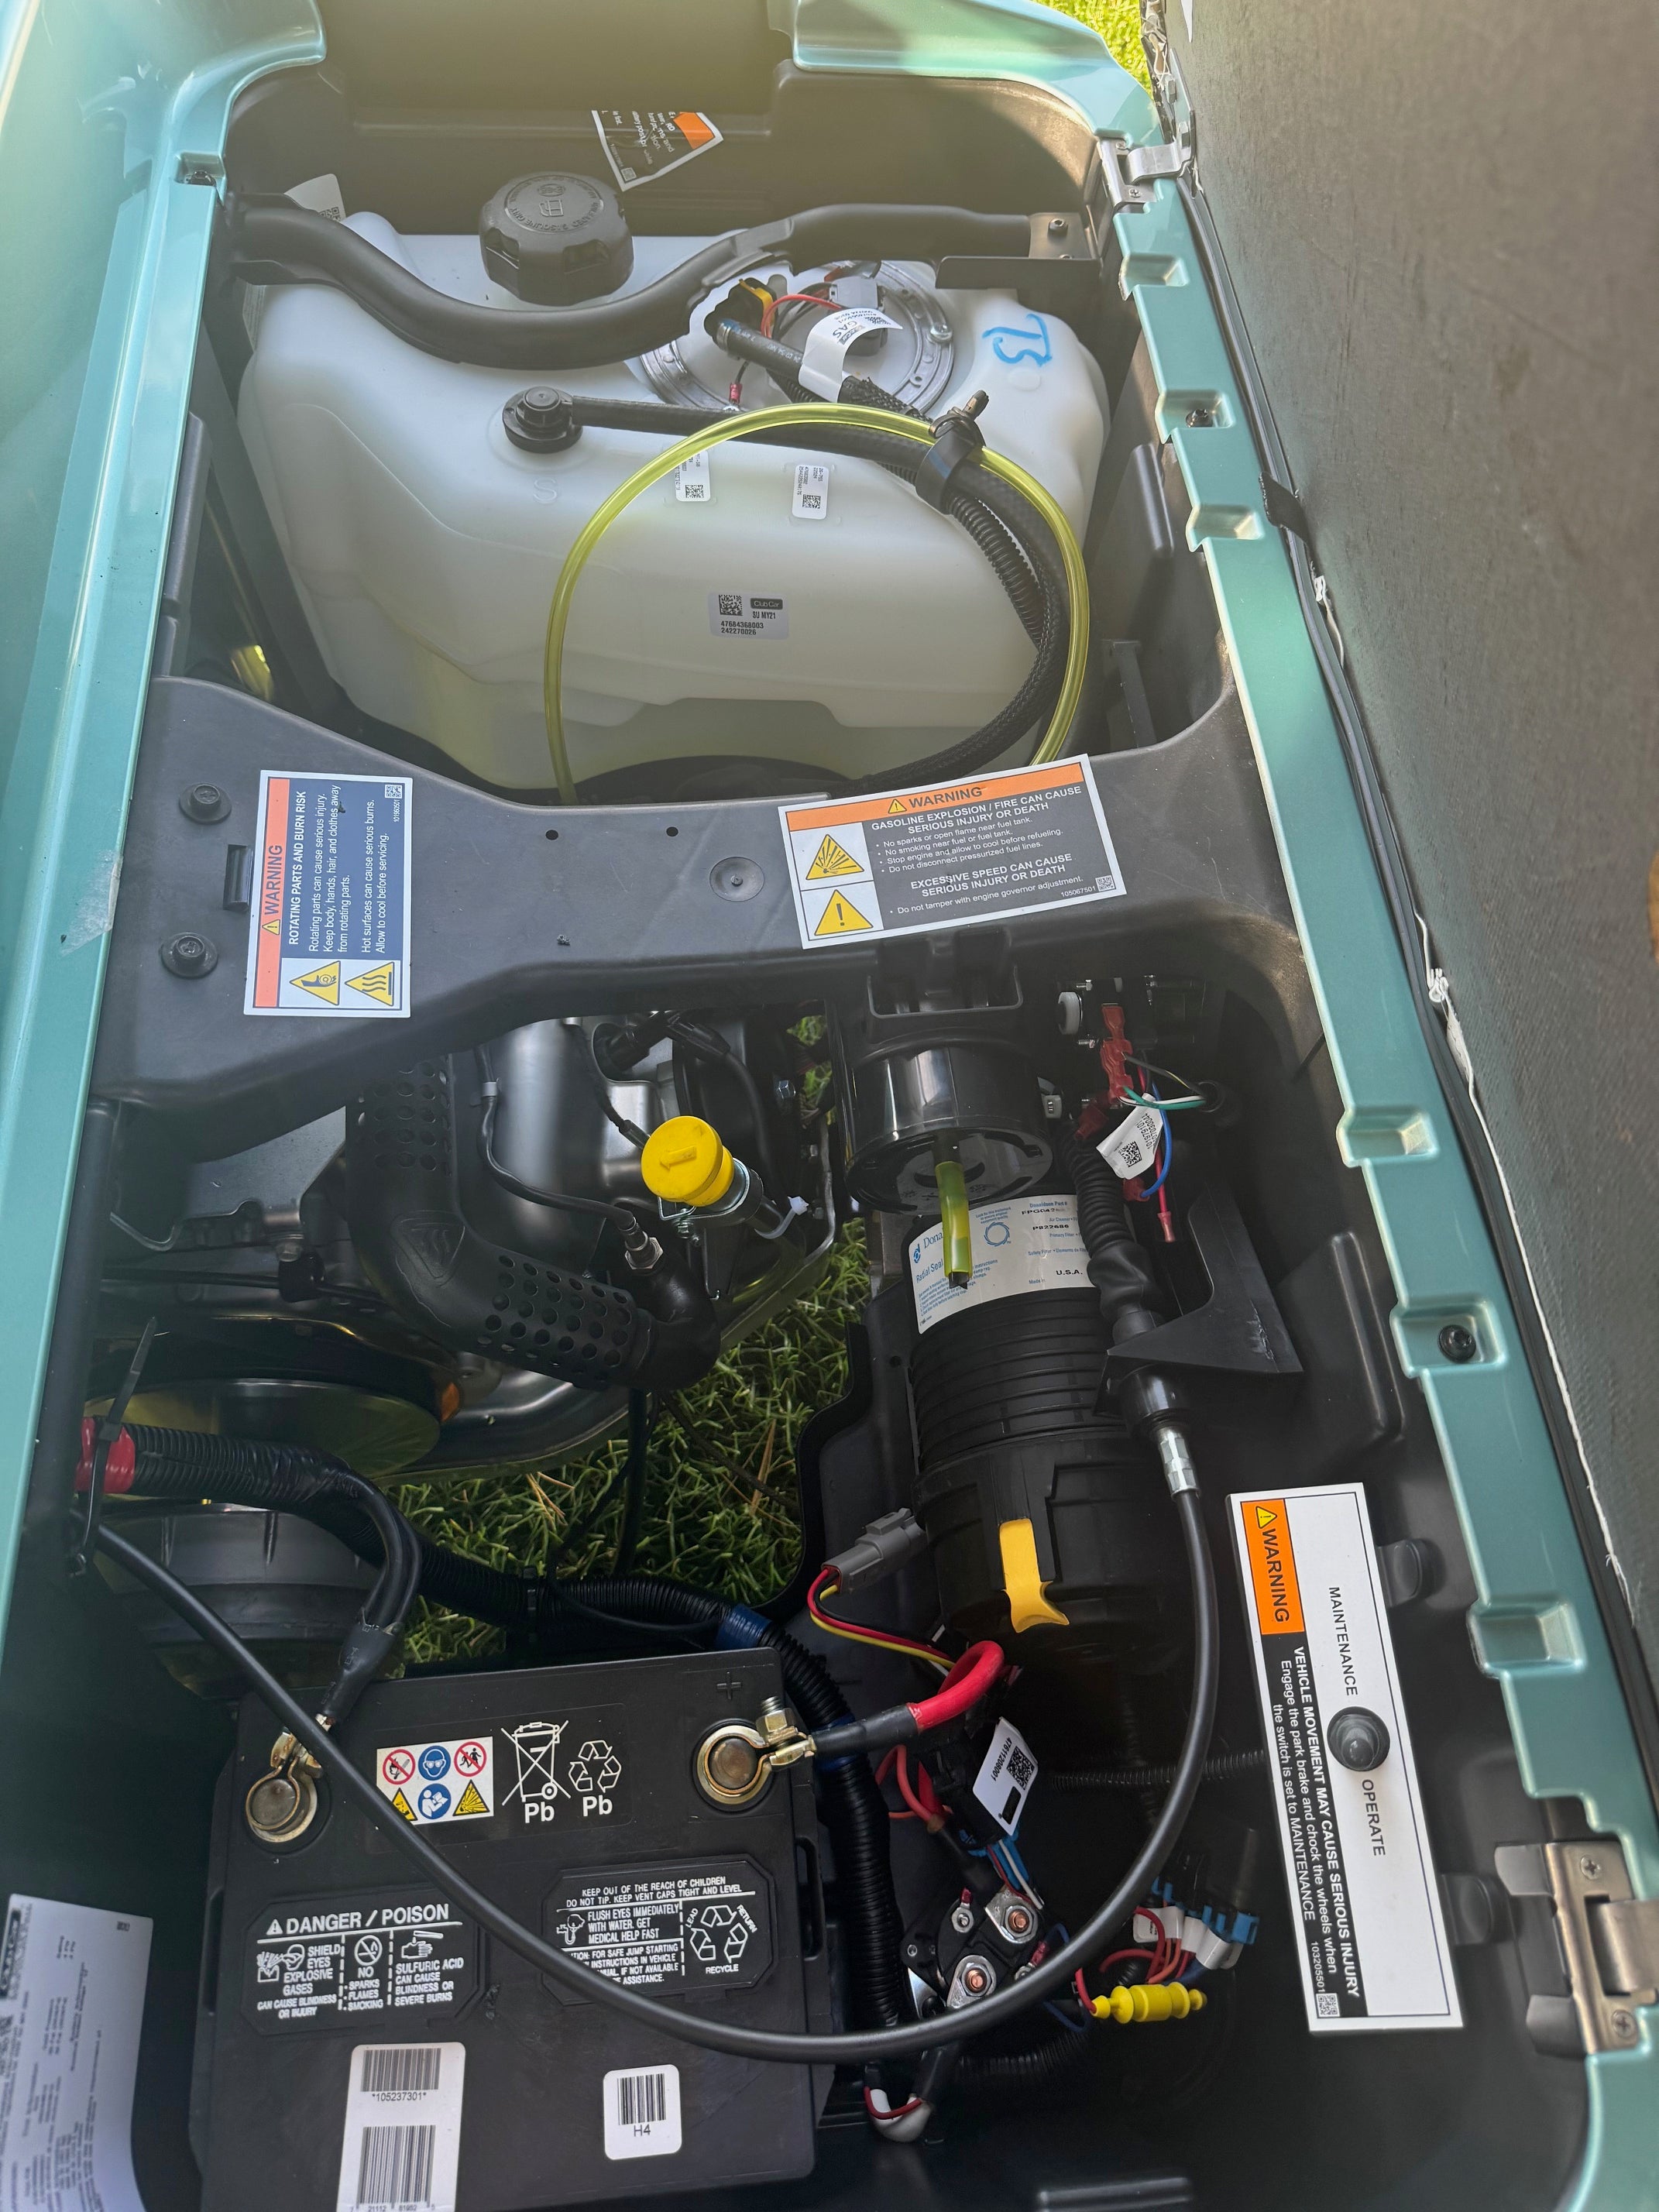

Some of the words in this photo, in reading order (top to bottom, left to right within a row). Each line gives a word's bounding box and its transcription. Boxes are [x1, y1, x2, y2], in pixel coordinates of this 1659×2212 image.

[833, 321, 857, 338] GAS
[295, 791, 306, 812] RISK
[314, 794, 327, 816] injury.
[331, 785, 341, 806] away
[908, 786, 982, 809] WARNING
[871, 815, 925, 830] GASOLINE
[926, 804, 986, 822] EXPLOSION
[994, 799, 1018, 809] FIRE
[1020, 794, 1042, 805] CAN
[1045, 786, 1082, 799] CAUSE
[908, 819, 954, 834] SERIOUS
[956, 812, 993, 826] INJURY
[996, 809, 1012, 819] OR
[1014, 802, 1049, 816] DEATH
[294, 815, 305, 840] BURN
[314, 819, 324, 848] serious
[328, 808, 338, 836] clothes
[897, 836, 922, 846] sparks
[933, 831, 953, 840] open
[954, 827, 976, 836] flame
[997, 819, 1012, 828] fuel
[1013, 816, 1032, 825] tank.
[293, 843, 304, 863] AND
[327, 838, 337, 854] and
[314, 850, 323, 874] cause
[326, 856, 338, 873] hair,
[910, 872, 970, 889] EXCESSIVE
[972, 866, 1008, 878] SPEED
[1010, 861, 1032, 871] CAN
[1035, 854, 1072, 867] CAUSE
[264, 845, 283, 915] WARNING
[291, 864, 302, 895] PARTS
[325, 875, 337, 903] hands,
[340, 874, 352, 898] parts.
[1060, 885, 1096, 897] 105067501
[311, 893, 322, 914] parts
[925, 900, 953, 909] tamper
[954, 896, 971, 905] with
[972, 892, 999, 902] engine
[1001, 885, 1036, 898] governor
[1038, 875, 1084, 890] adjustment.
[288, 897, 301, 945] ROTATING
[324, 904, 337, 928] body,
[338, 899, 352, 931] rotating
[308, 916, 322, 951] Rotating
[323, 929, 336, 952] Keep
[337, 933, 348, 953] from
[1262, 1528, 1290, 1622] WARNING
[1328, 1587, 1358, 1695] MAINTENANCE
[1281, 1660, 1295, 1705] Engage
[1294, 1646, 1312, 1703] VEHICLE
[1288, 1708, 1300, 1727] the
[1290, 1730, 1305, 1757] park
[1303, 1706, 1325, 1784] MOVEMENT
[1297, 1760, 1310, 1794] brake
[524, 1802, 555, 1823] Pb
[582, 1795, 613, 1817] Pb
[1302, 1798, 1316, 1820] and
[1316, 1788, 1331, 1817] MAY
[1362, 1779, 1386, 1856] OPERATE
[1307, 1824, 1321, 1861] chock
[1321, 1820, 1339, 1870] CAUSE
[1313, 1864, 1324, 1885] the
[582, 1887, 601, 1897] KEEP
[603, 1886, 617, 1895] OUT
[620, 1884, 631, 1894] OF
[634, 1883, 648, 1892] THE
[651, 1881, 675, 1891] REACH
[677, 1879, 688, 1888] OF
[689, 1876, 726, 1887] CHILDREN
[588, 1909, 610, 1922] FLUSH
[613, 1908, 631, 1919] EYES
[633, 1903, 679, 1917] IMMEDIATELY
[1317, 1887, 1332, 1934] wheels
[1330, 1873, 1350, 1939] SERIOUS
[287, 1911, 362, 1935] DANGER
[382, 1903, 448, 1925] POISON
[588, 1922, 606, 1932] WITH
[637, 1917, 651, 1929] GET
[685, 1907, 699, 1929] LEAD
[737, 1905, 757, 1934] RETURN
[589, 1932, 620, 1944] MEDICAL
[621, 1929, 640, 1942] HELP
[641, 1928, 659, 1939] FAST
[307, 1943, 340, 1957] SHIELD
[1324, 1937, 1337, 1973] when
[307, 1956, 331, 1969] EYES
[358, 1966, 374, 1978] NO
[395, 1960, 440, 1975] SULFURIC
[441, 1957, 464, 1970] ACID
[706, 1963, 739, 1974] RECYCLE
[1311, 1942, 1325, 1992] 103205501
[1340, 1942, 1359, 1997] INJURY
[283, 1967, 333, 1984] EXPLOSIVE
[349, 1978, 380, 1990] SPARKS
[395, 1974, 412, 1985] CAN
[414, 1971, 441, 1984] CAUSE
[283, 1983, 313, 1996] GASES
[348, 1989, 379, 2001] FLAMES
[394, 1994, 424, 2007] SEVERE
[426, 1991, 452, 2003] BURNS
[395, 1982, 439, 1995] BLINDNESS
[441, 1980, 454, 1990] OR
[257, 2001, 273, 2011] CAN
[273, 1997, 297, 2009] CAUSE
[299, 1994, 337, 2006] BLINDNESS
[278, 2009, 290, 2019] OR
[291, 2006, 318, 2017] INJURY
[348, 1998, 383, 2011] SMOKING
[634, 2124, 651, 2138] H4
